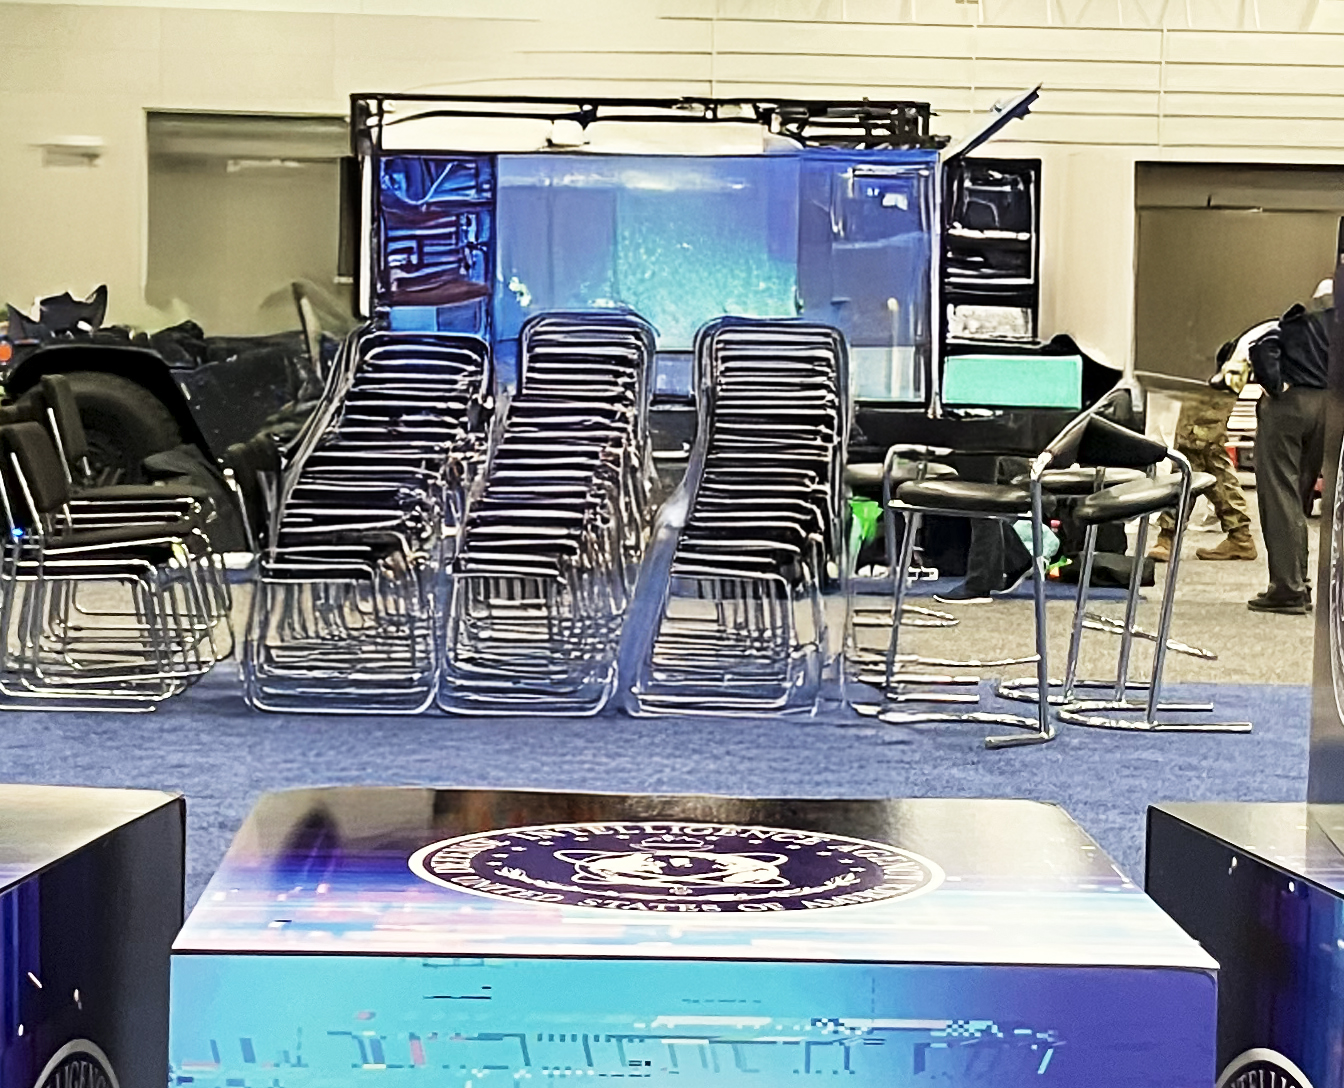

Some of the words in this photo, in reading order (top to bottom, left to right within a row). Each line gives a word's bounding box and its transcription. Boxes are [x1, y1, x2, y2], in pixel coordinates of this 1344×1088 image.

[507, 825, 831, 845] INTELLIGENCE
[451, 875, 565, 901] UNITED
[577, 898, 722, 912] STATES
[737, 902, 786, 911] OF
